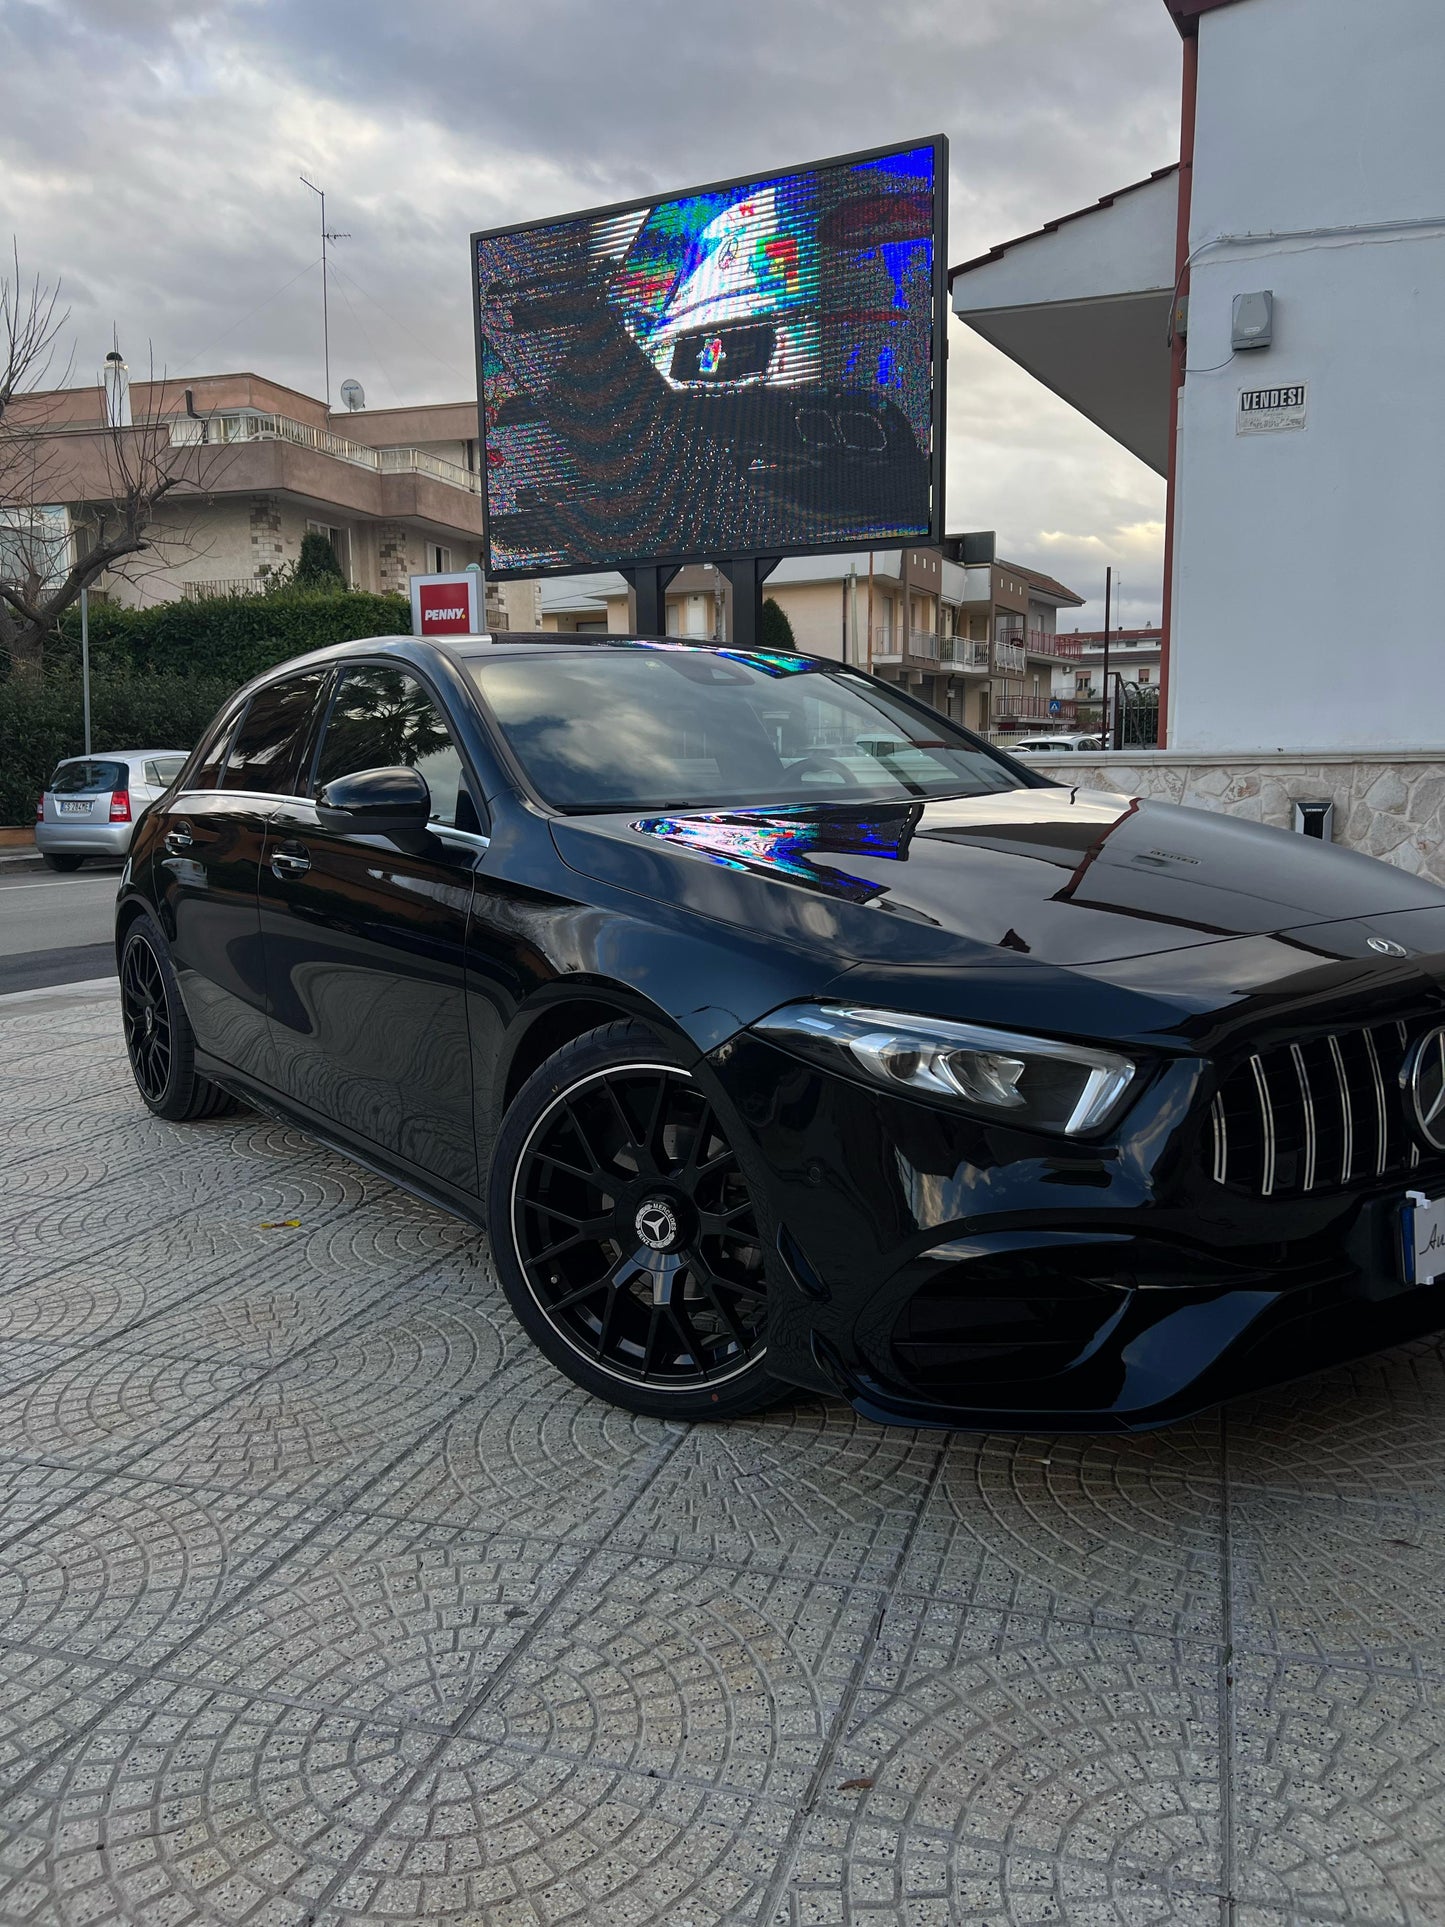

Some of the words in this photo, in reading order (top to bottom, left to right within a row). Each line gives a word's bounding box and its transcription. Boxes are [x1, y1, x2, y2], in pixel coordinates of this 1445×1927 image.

[1243, 388, 1303, 410] VENDESI
[652, 1203, 677, 1232] MERCEDES
[636, 1229, 650, 1246] BENZ
